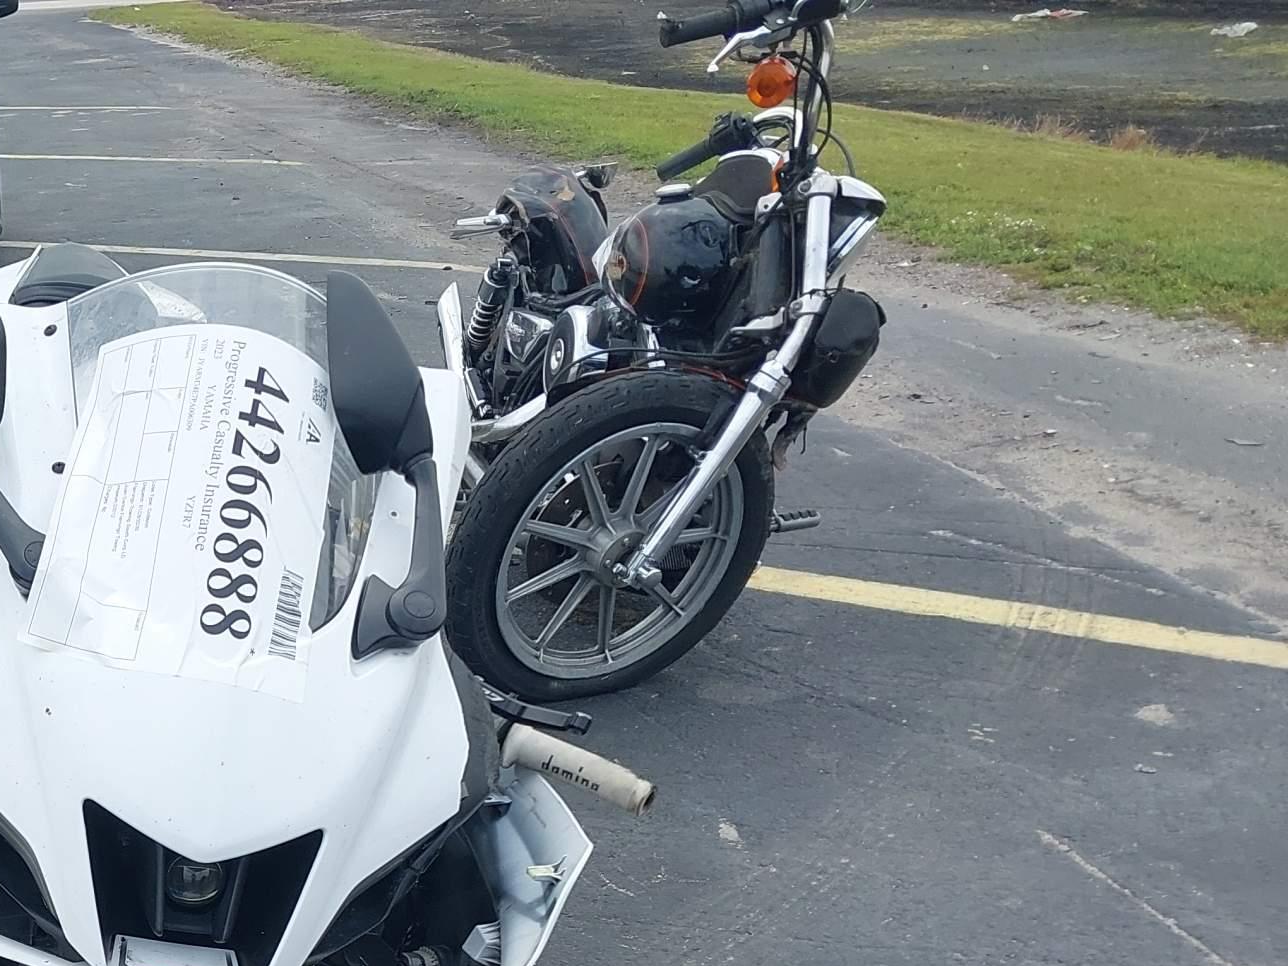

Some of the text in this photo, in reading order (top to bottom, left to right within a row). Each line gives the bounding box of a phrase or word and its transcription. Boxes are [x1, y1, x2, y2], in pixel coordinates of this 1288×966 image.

[182, 338, 226, 528] 2023 YAMAHA YZFR7
[194, 340, 247, 552] Progressive Casualty Insurance
[199, 366, 290, 640] 44266888
